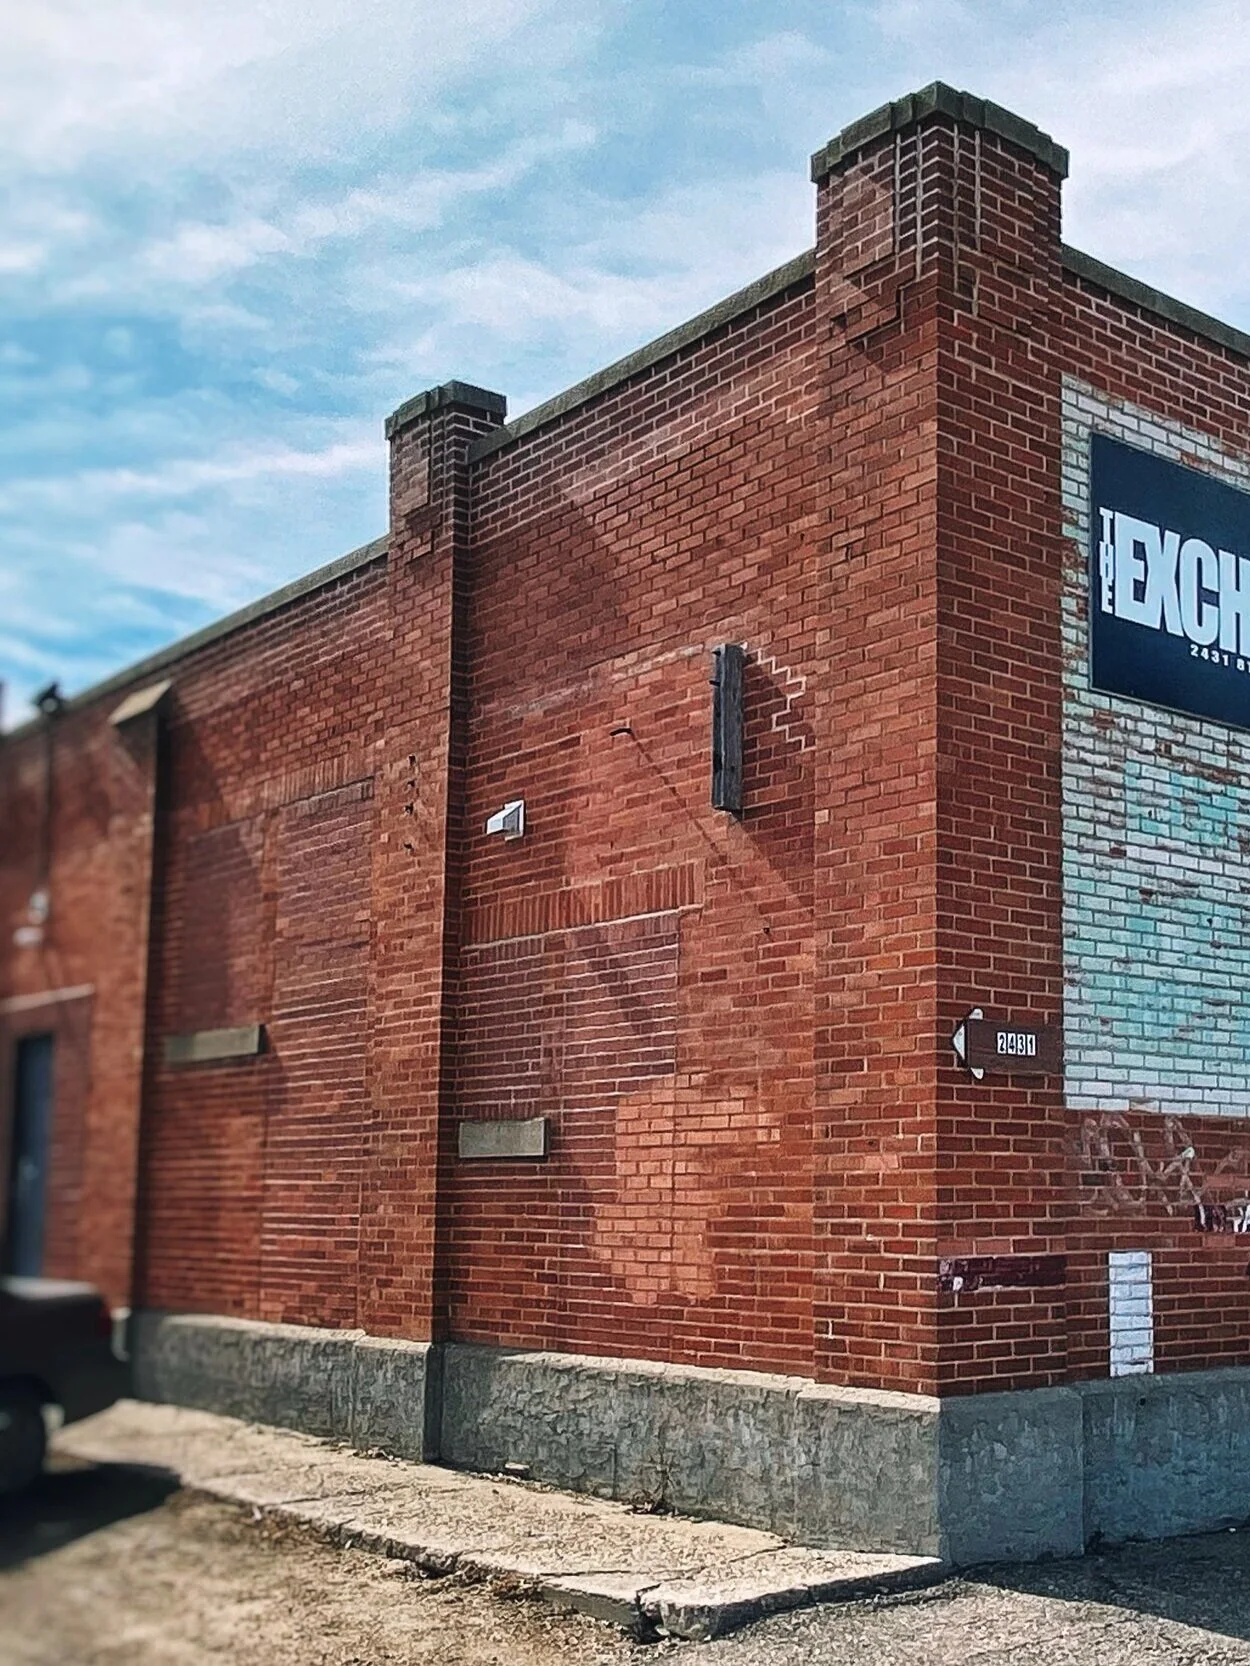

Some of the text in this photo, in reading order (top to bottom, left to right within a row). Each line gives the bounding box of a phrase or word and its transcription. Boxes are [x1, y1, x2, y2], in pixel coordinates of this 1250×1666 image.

[1099, 506, 1114, 614] THE
[1190, 644, 1229, 666] 2431
[997, 1032, 1036, 1056] 2431
